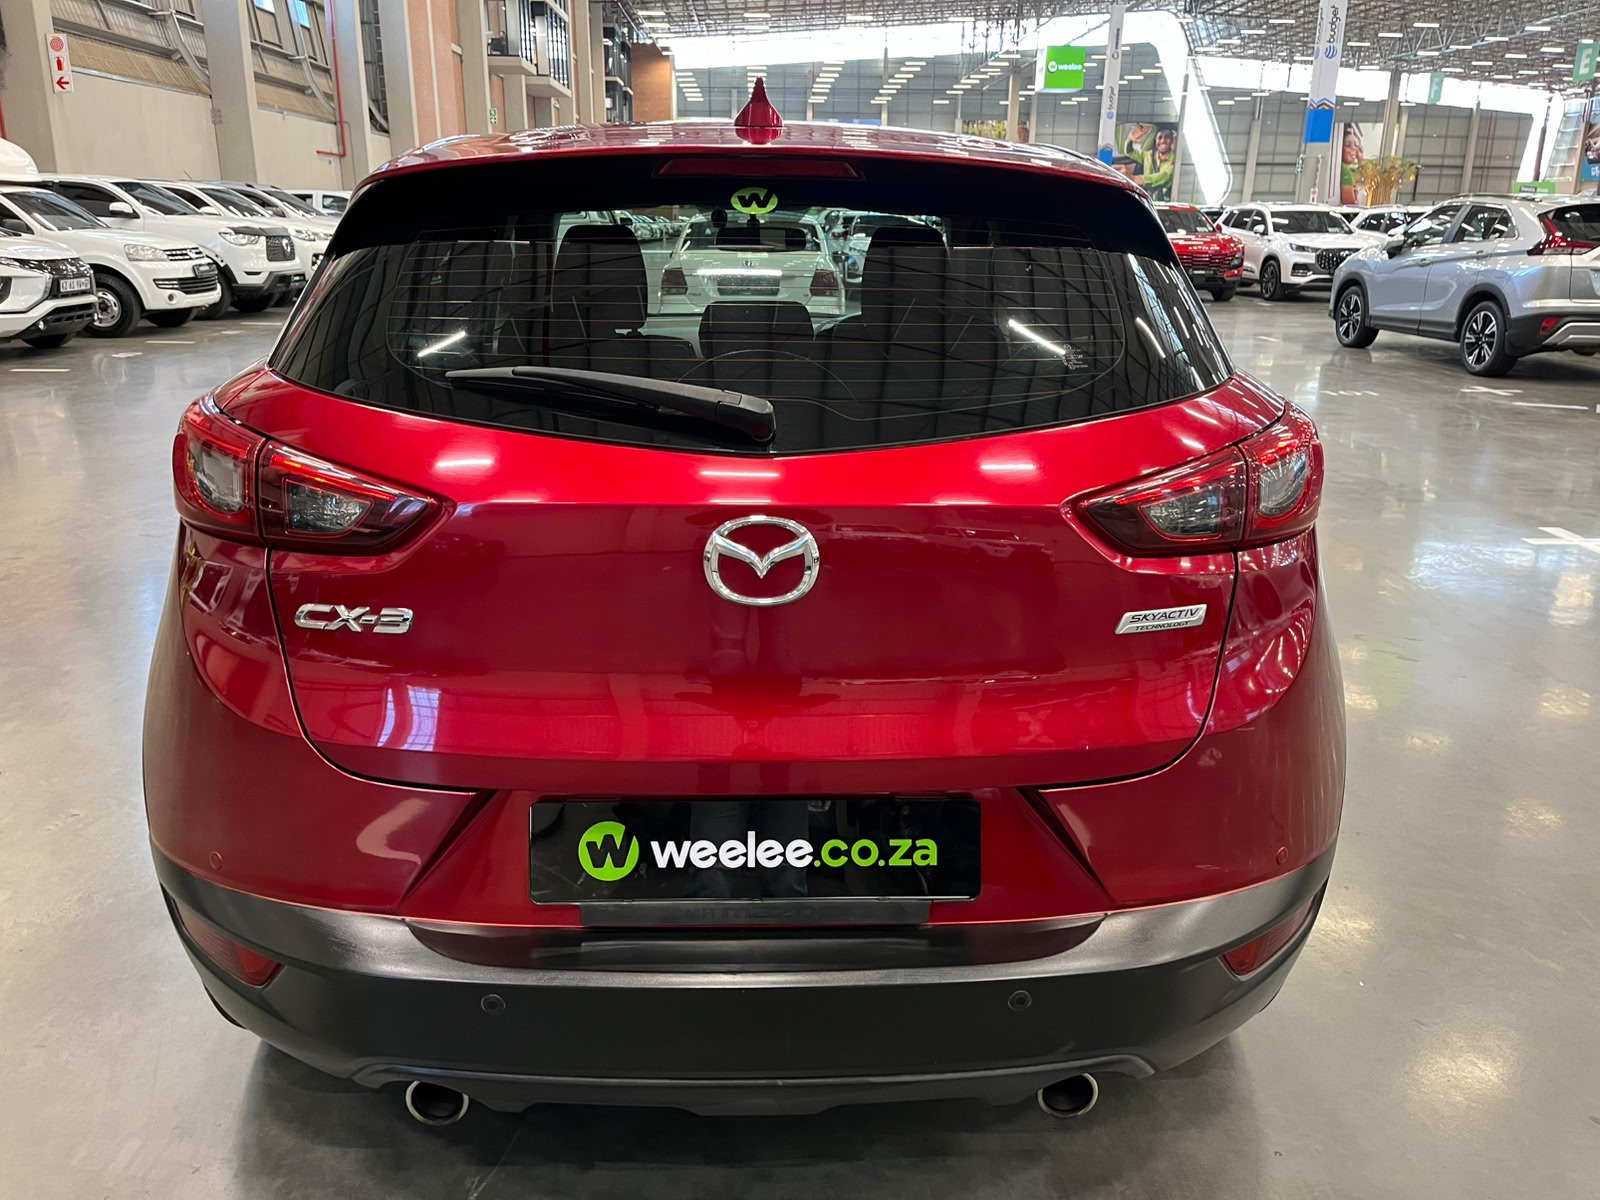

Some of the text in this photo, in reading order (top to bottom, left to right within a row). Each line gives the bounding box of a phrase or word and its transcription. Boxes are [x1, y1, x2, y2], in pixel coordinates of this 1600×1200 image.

[1327, 4, 1341, 43] budget
[1579, 48, 1593, 75] E
[294, 603, 414, 634] CX-3
[1129, 608, 1200, 623] SKYACTIV
[1135, 620, 1191, 631] TECHNOLOGY
[650, 830, 938, 869] weelee.co.za
